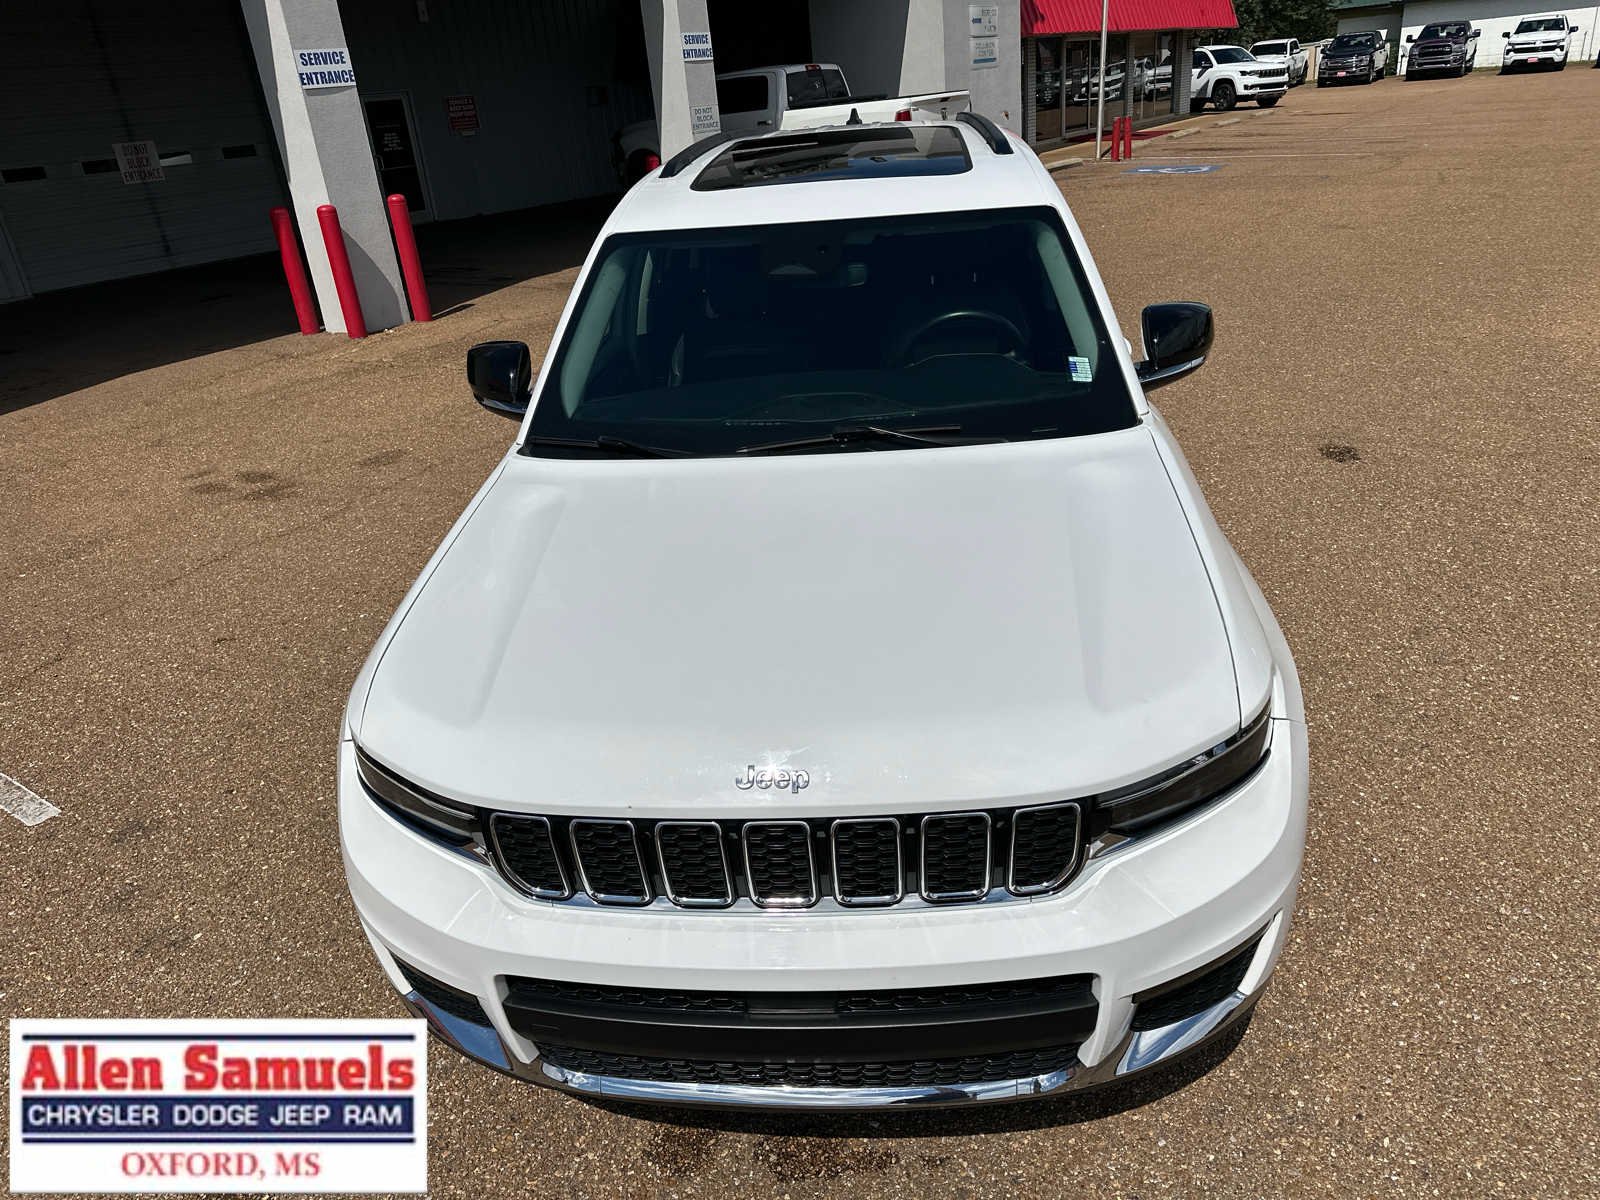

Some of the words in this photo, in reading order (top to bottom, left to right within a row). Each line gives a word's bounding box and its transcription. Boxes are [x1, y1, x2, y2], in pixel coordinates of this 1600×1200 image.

[683, 34, 709, 45] SERVICE
[299, 51, 346, 66] SERVICE
[682, 48, 713, 59] ENTRANCE
[298, 70, 356, 86] ENTRANCE
[735, 764, 810, 794] Jeep
